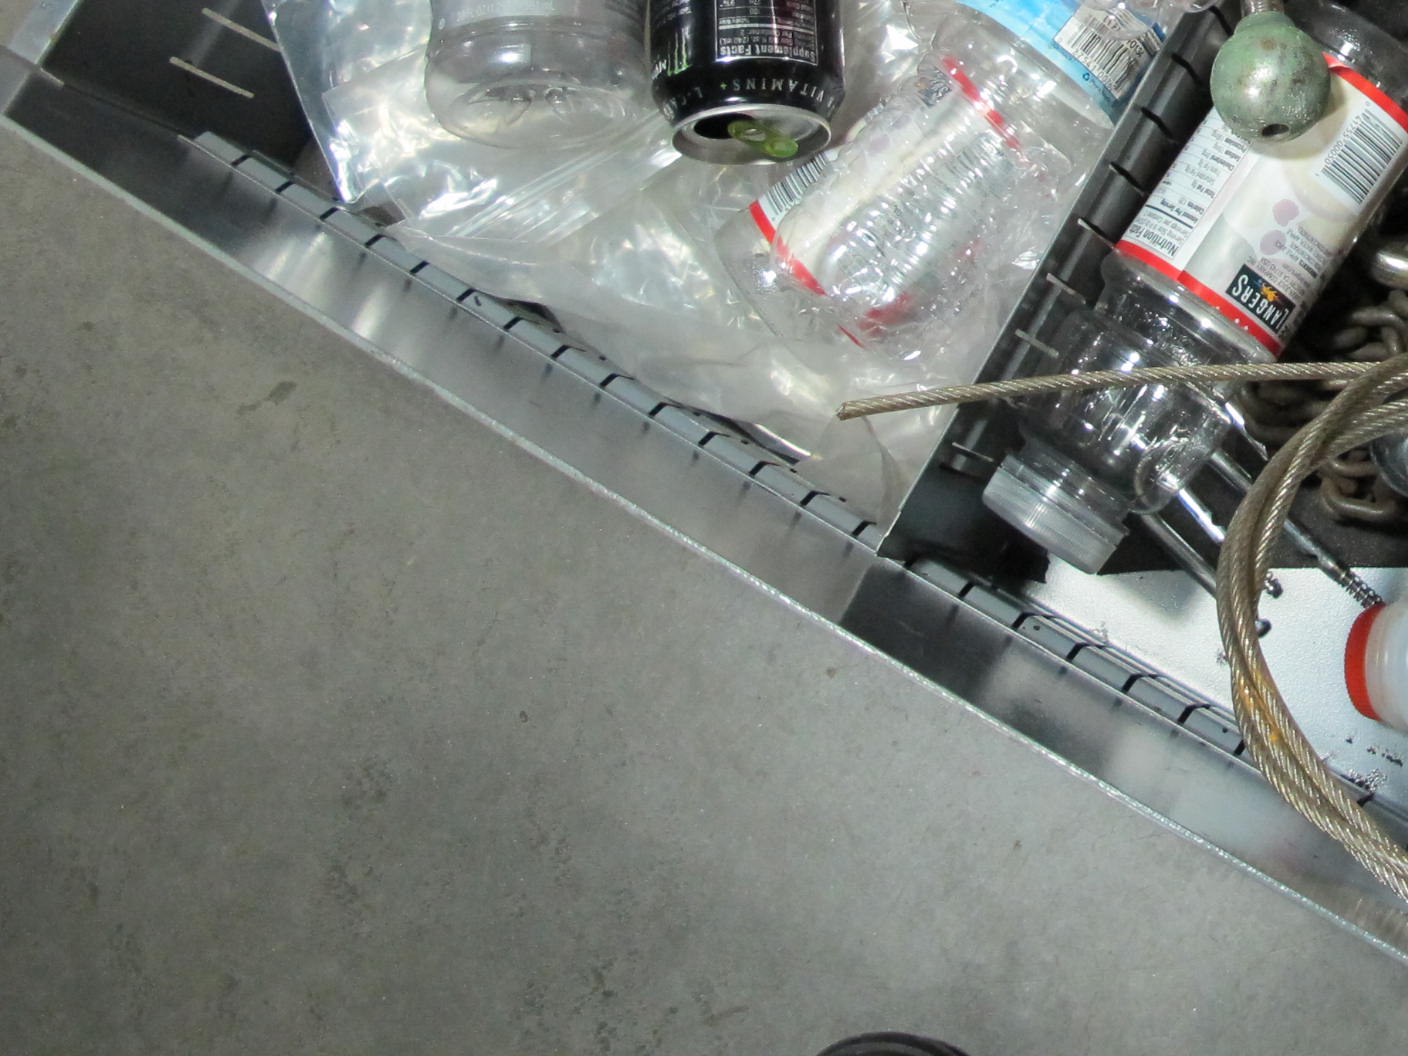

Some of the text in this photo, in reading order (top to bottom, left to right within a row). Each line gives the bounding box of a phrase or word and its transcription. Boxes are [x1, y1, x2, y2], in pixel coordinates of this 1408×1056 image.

[720, 45, 817, 63] Supplement Facts
[733, 78, 825, 103] VITAMINS
[1143, 230, 1179, 257] Nutrition
[1231, 274, 1290, 329] LANGERS
